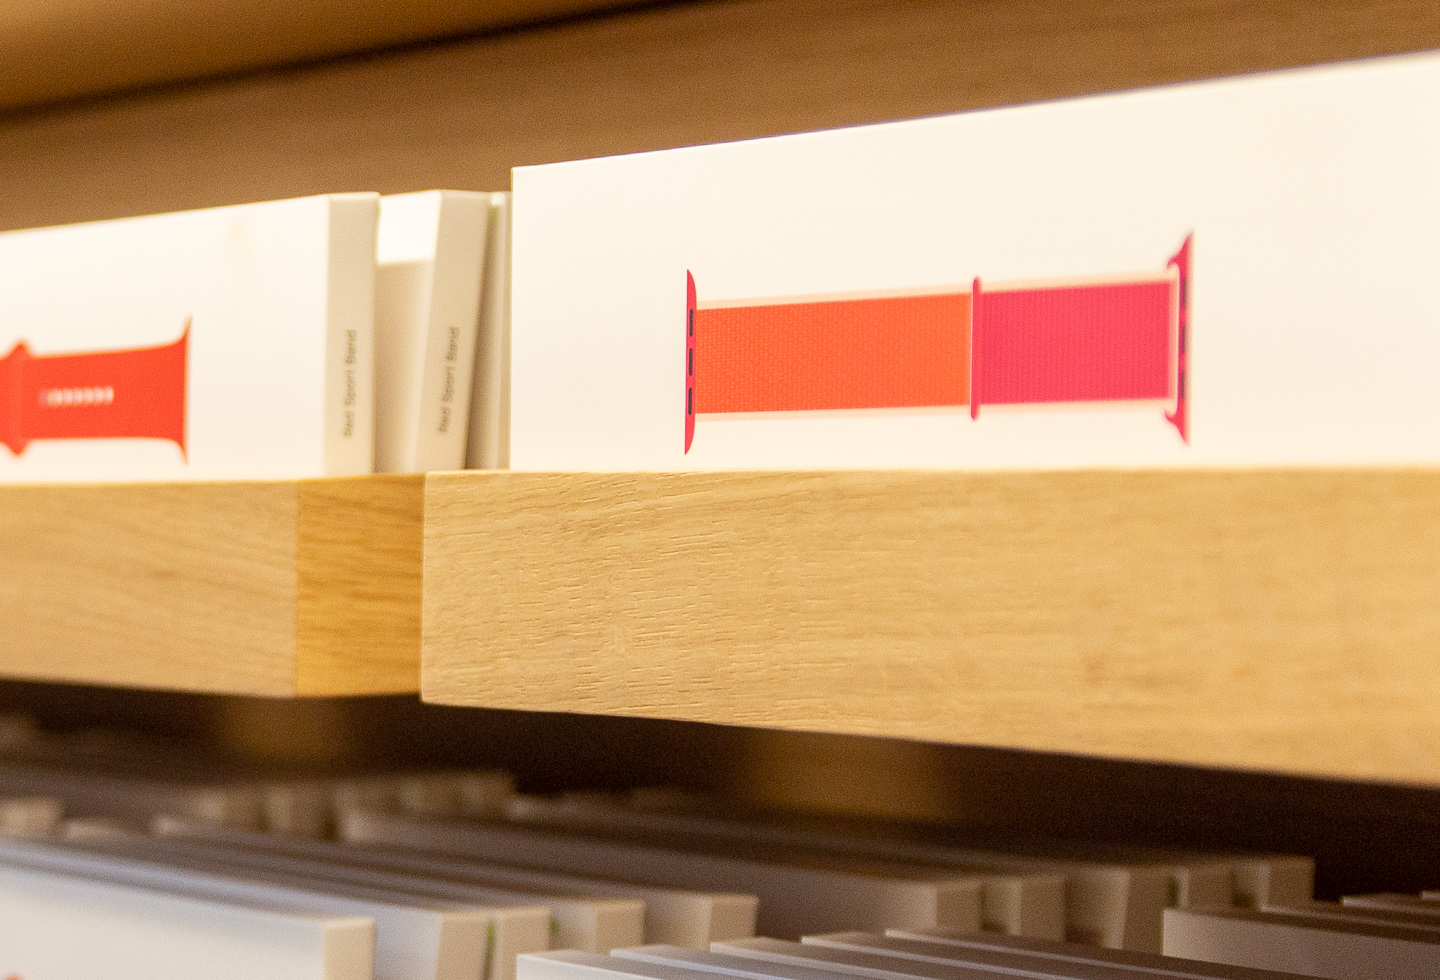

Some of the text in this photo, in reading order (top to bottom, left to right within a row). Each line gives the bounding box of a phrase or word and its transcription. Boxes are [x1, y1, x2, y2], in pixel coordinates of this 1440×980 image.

[343, 330, 357, 437] Red Sport Band
[438, 326, 459, 433] Red Sport Band
